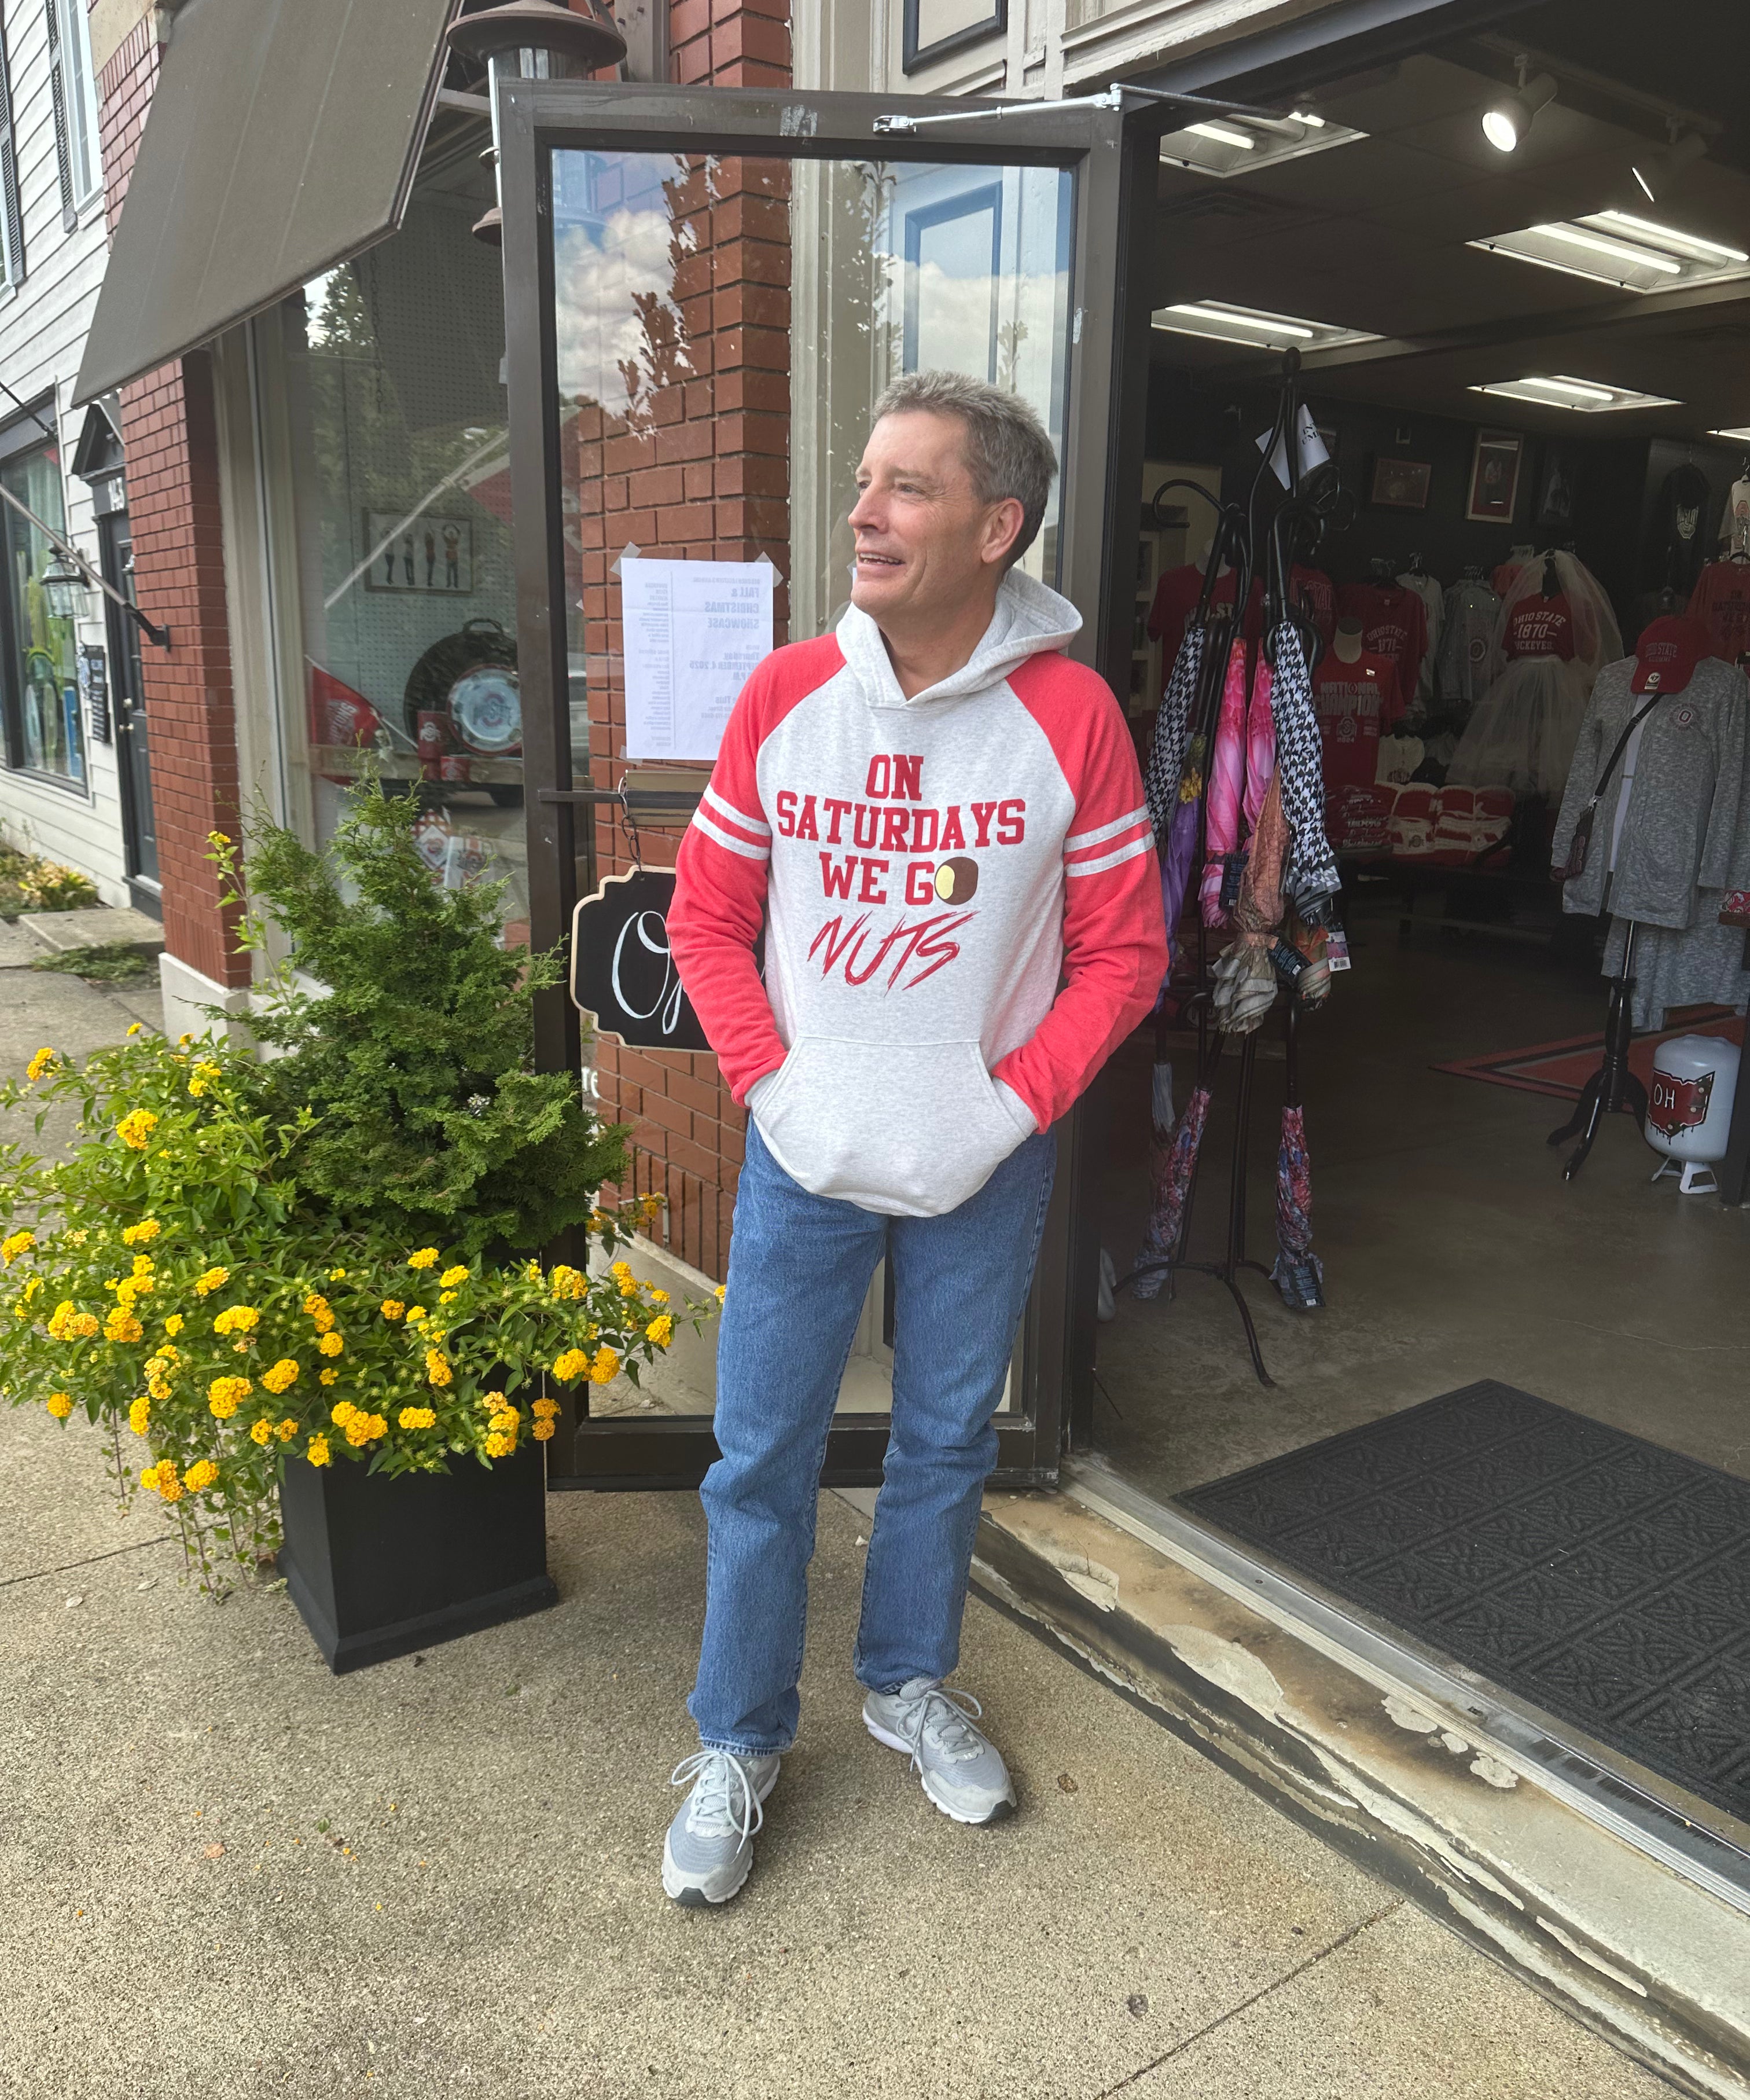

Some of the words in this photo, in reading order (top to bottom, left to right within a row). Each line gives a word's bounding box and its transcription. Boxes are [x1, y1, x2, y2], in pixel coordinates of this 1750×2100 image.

[1514, 612, 1535, 625] OHIO
[1535, 611, 1566, 627] STATE
[865, 754, 924, 801] ON
[777, 790, 1025, 853] SATURDAYS
[819, 851, 889, 905] WE
[807, 910, 981, 998] NUTS
[1653, 1083, 1675, 1110] OH
